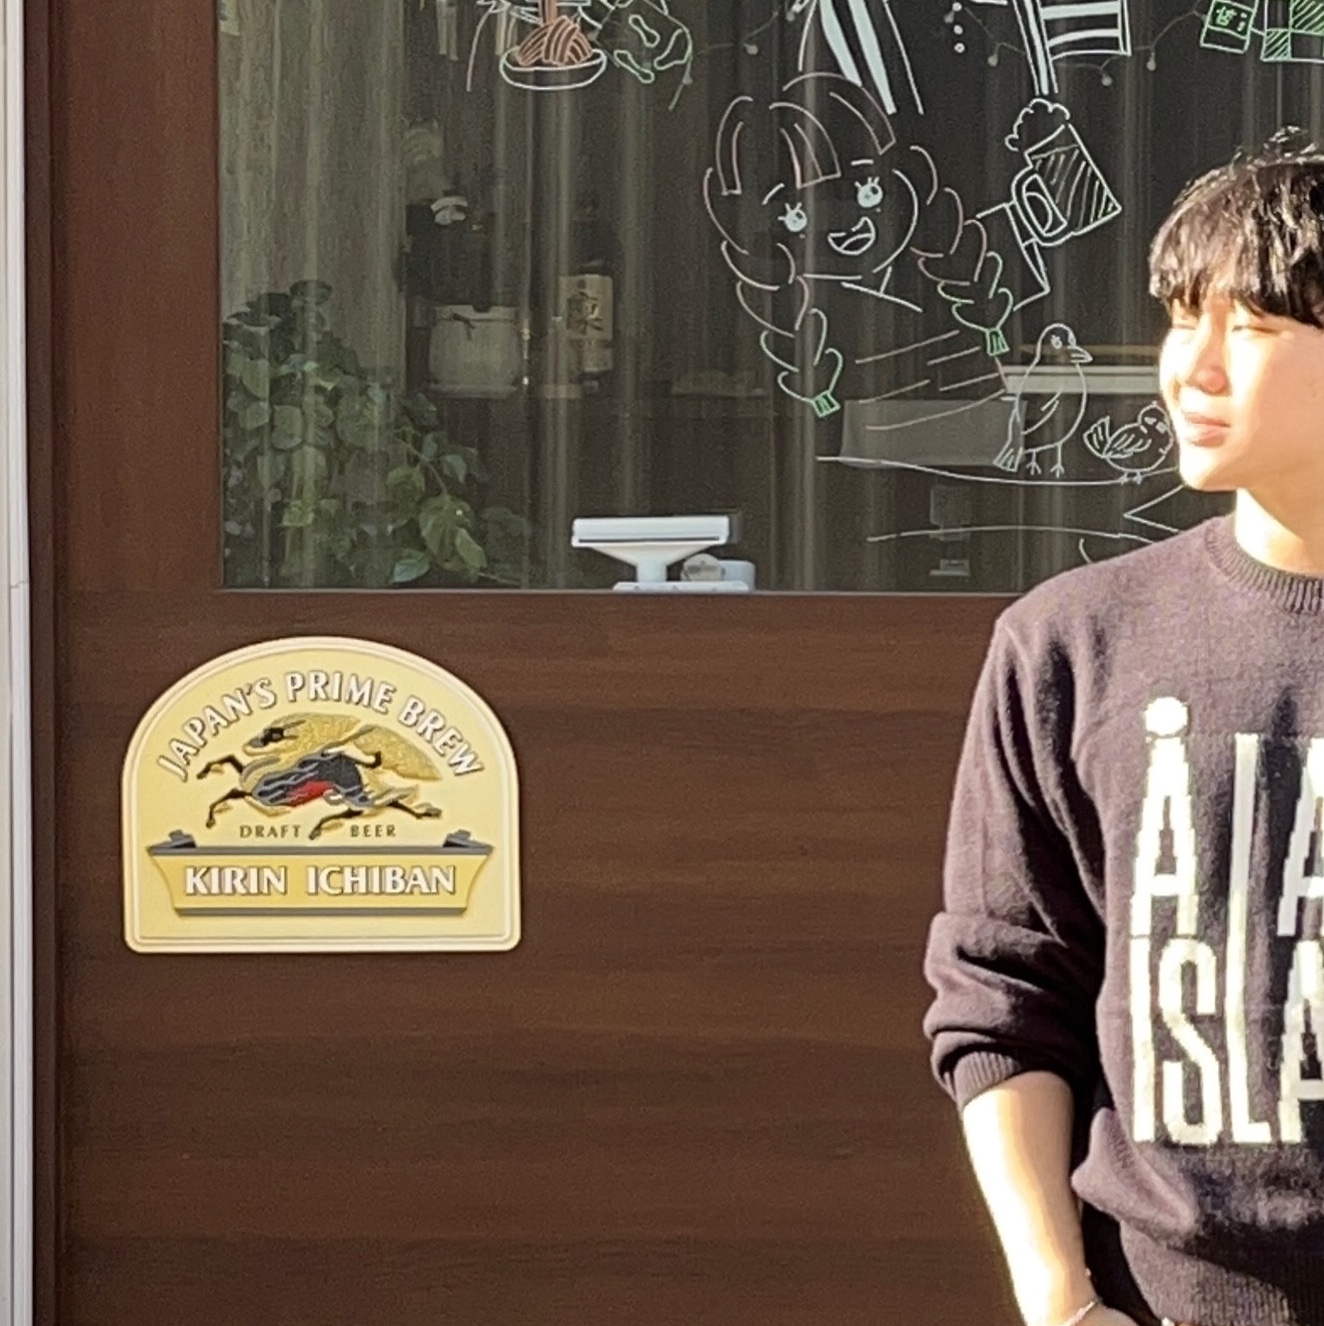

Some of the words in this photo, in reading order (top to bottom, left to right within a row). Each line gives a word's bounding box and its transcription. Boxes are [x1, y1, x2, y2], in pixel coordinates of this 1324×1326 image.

[156, 678, 278, 782] JAPAN'S
[285, 671, 397, 714] PRIME
[398, 696, 484, 777] BREW
[239, 824, 302, 839] DRAFT
[350, 824, 397, 838] BEER
[184, 865, 288, 896] KIRIN
[306, 865, 456, 896] ICHIBAN
